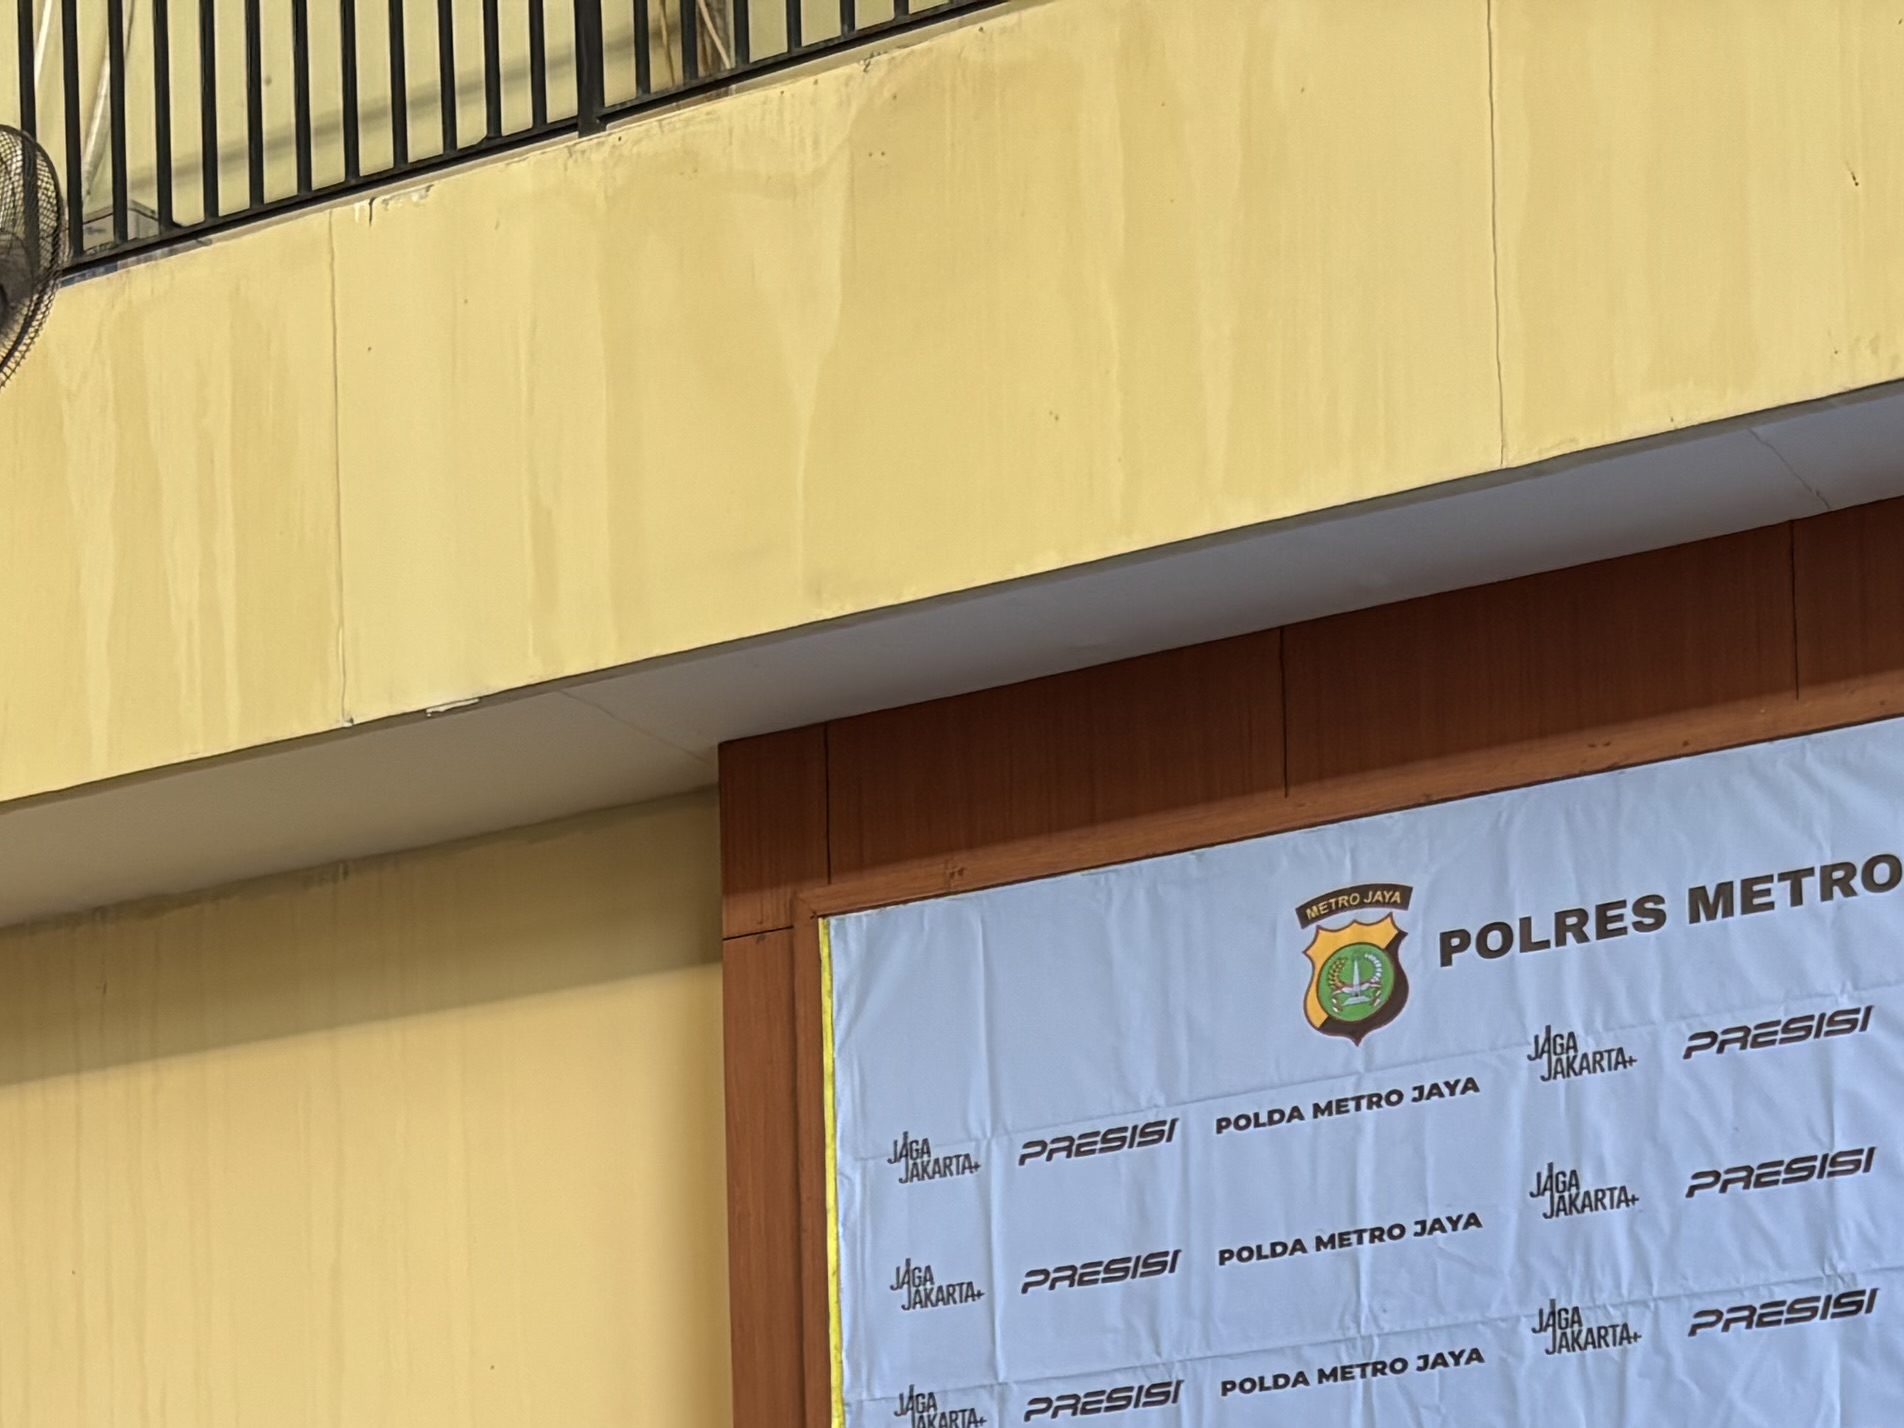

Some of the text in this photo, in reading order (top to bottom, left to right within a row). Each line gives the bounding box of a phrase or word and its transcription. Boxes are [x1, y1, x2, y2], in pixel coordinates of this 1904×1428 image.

[1306, 890, 1401, 920] METRO JAYA
[1440, 895, 1666, 967] POLRES
[1527, 1025, 1578, 1060] JAGA
[1683, 1005, 1873, 1059] PRESISI
[1216, 1077, 1479, 1134] POLDA METRO JAYA
[887, 1132, 930, 1164] JAGA
[1019, 1118, 1178, 1165] PRESISI
[1532, 1299, 1583, 1334] JAGA
[1688, 1288, 1878, 1336] PRESISI
[1222, 1348, 1484, 1396] POLDA METRO JAYA
[894, 1385, 937, 1417] JAGA
[1024, 1380, 1184, 1422] PRESISI
